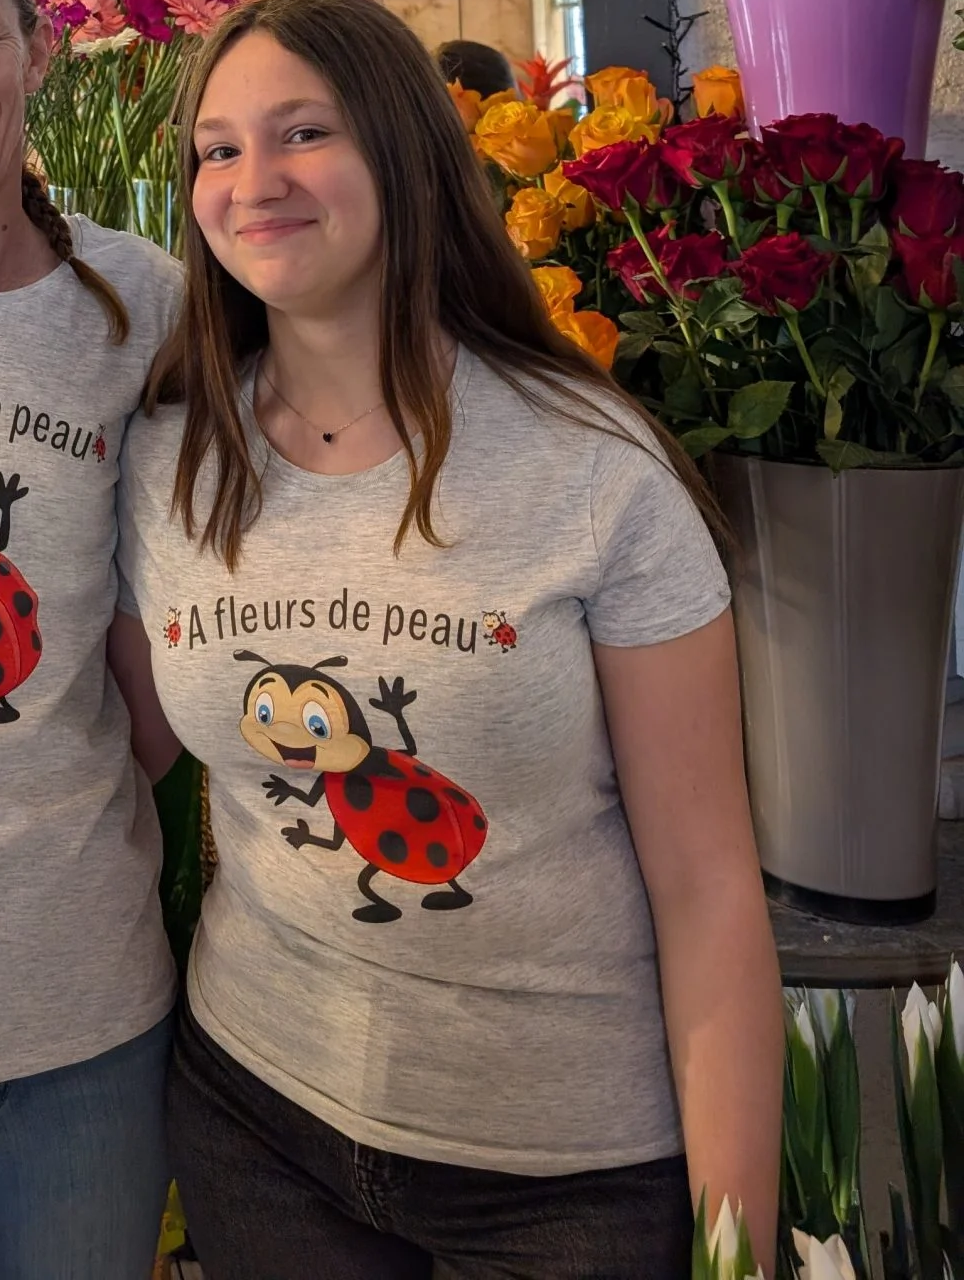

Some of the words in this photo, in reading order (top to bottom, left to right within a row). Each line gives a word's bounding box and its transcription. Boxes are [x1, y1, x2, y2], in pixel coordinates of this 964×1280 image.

[8, 402, 93, 461] peau
[188, 604, 208, 650] A
[214, 595, 317, 640] fleurs
[328, 588, 371, 632] de
[382, 602, 477, 655] peau
